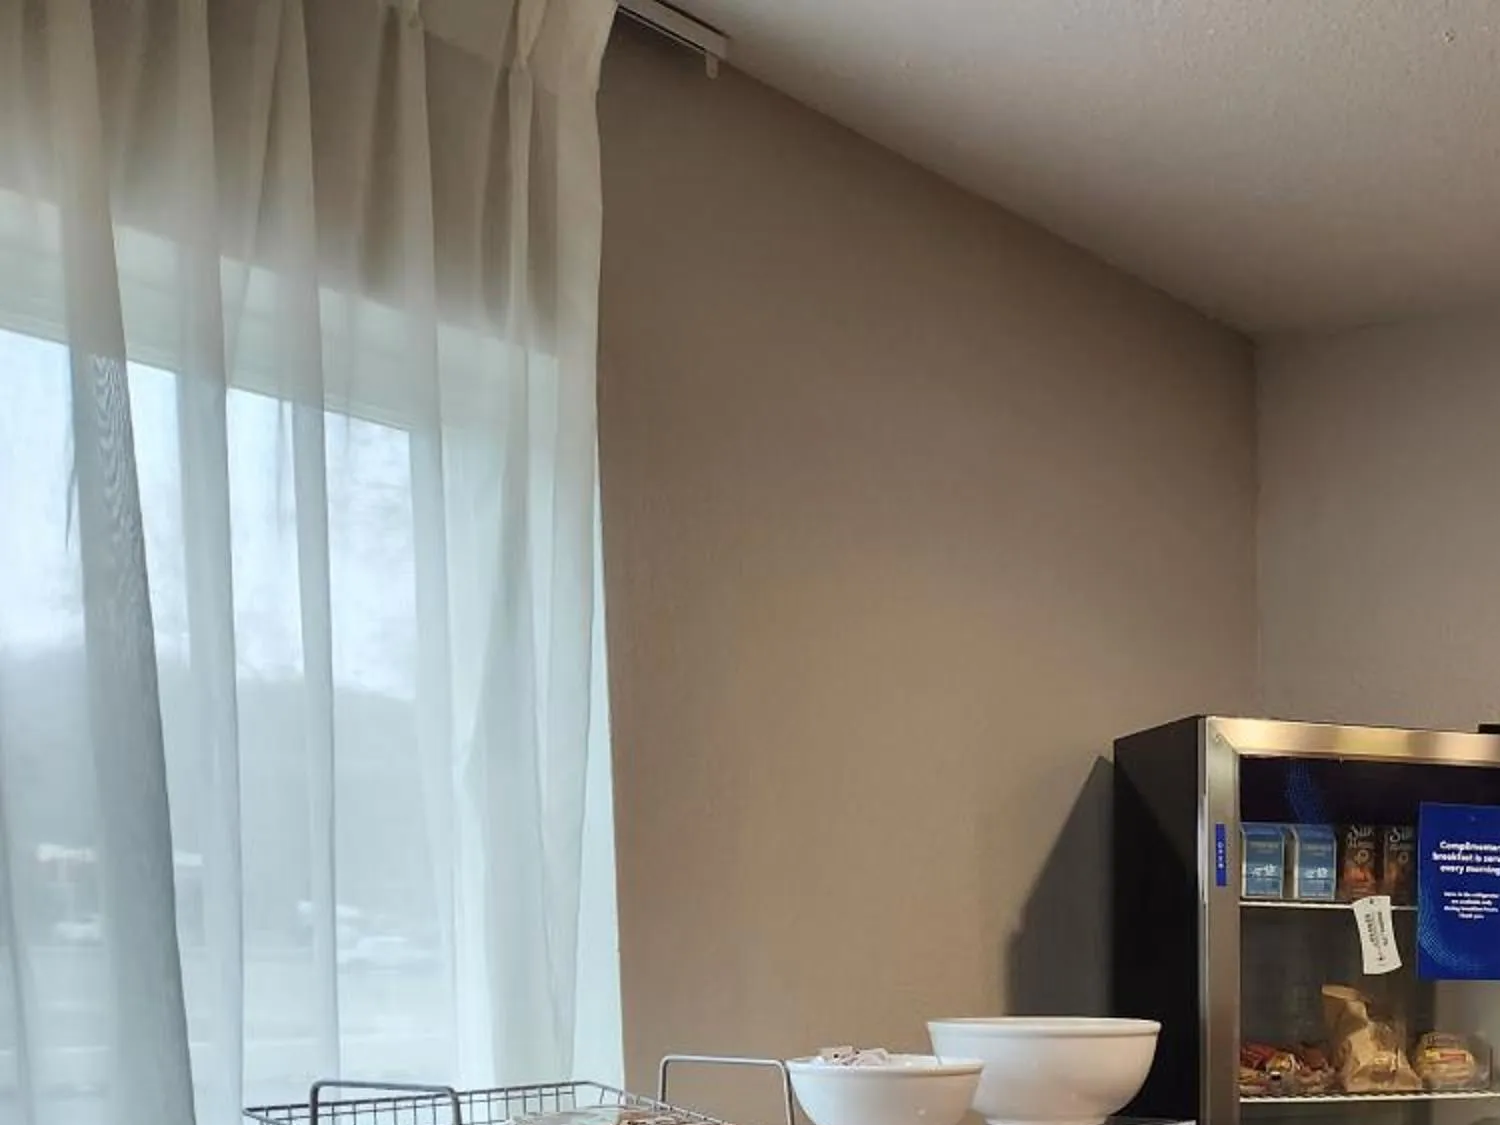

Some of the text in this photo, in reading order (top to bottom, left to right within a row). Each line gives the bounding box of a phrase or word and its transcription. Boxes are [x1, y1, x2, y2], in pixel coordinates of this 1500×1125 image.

[1432, 851, 1472, 861] breakfast
[1474, 854, 1482, 862] is
[1440, 865, 1464, 875] every
